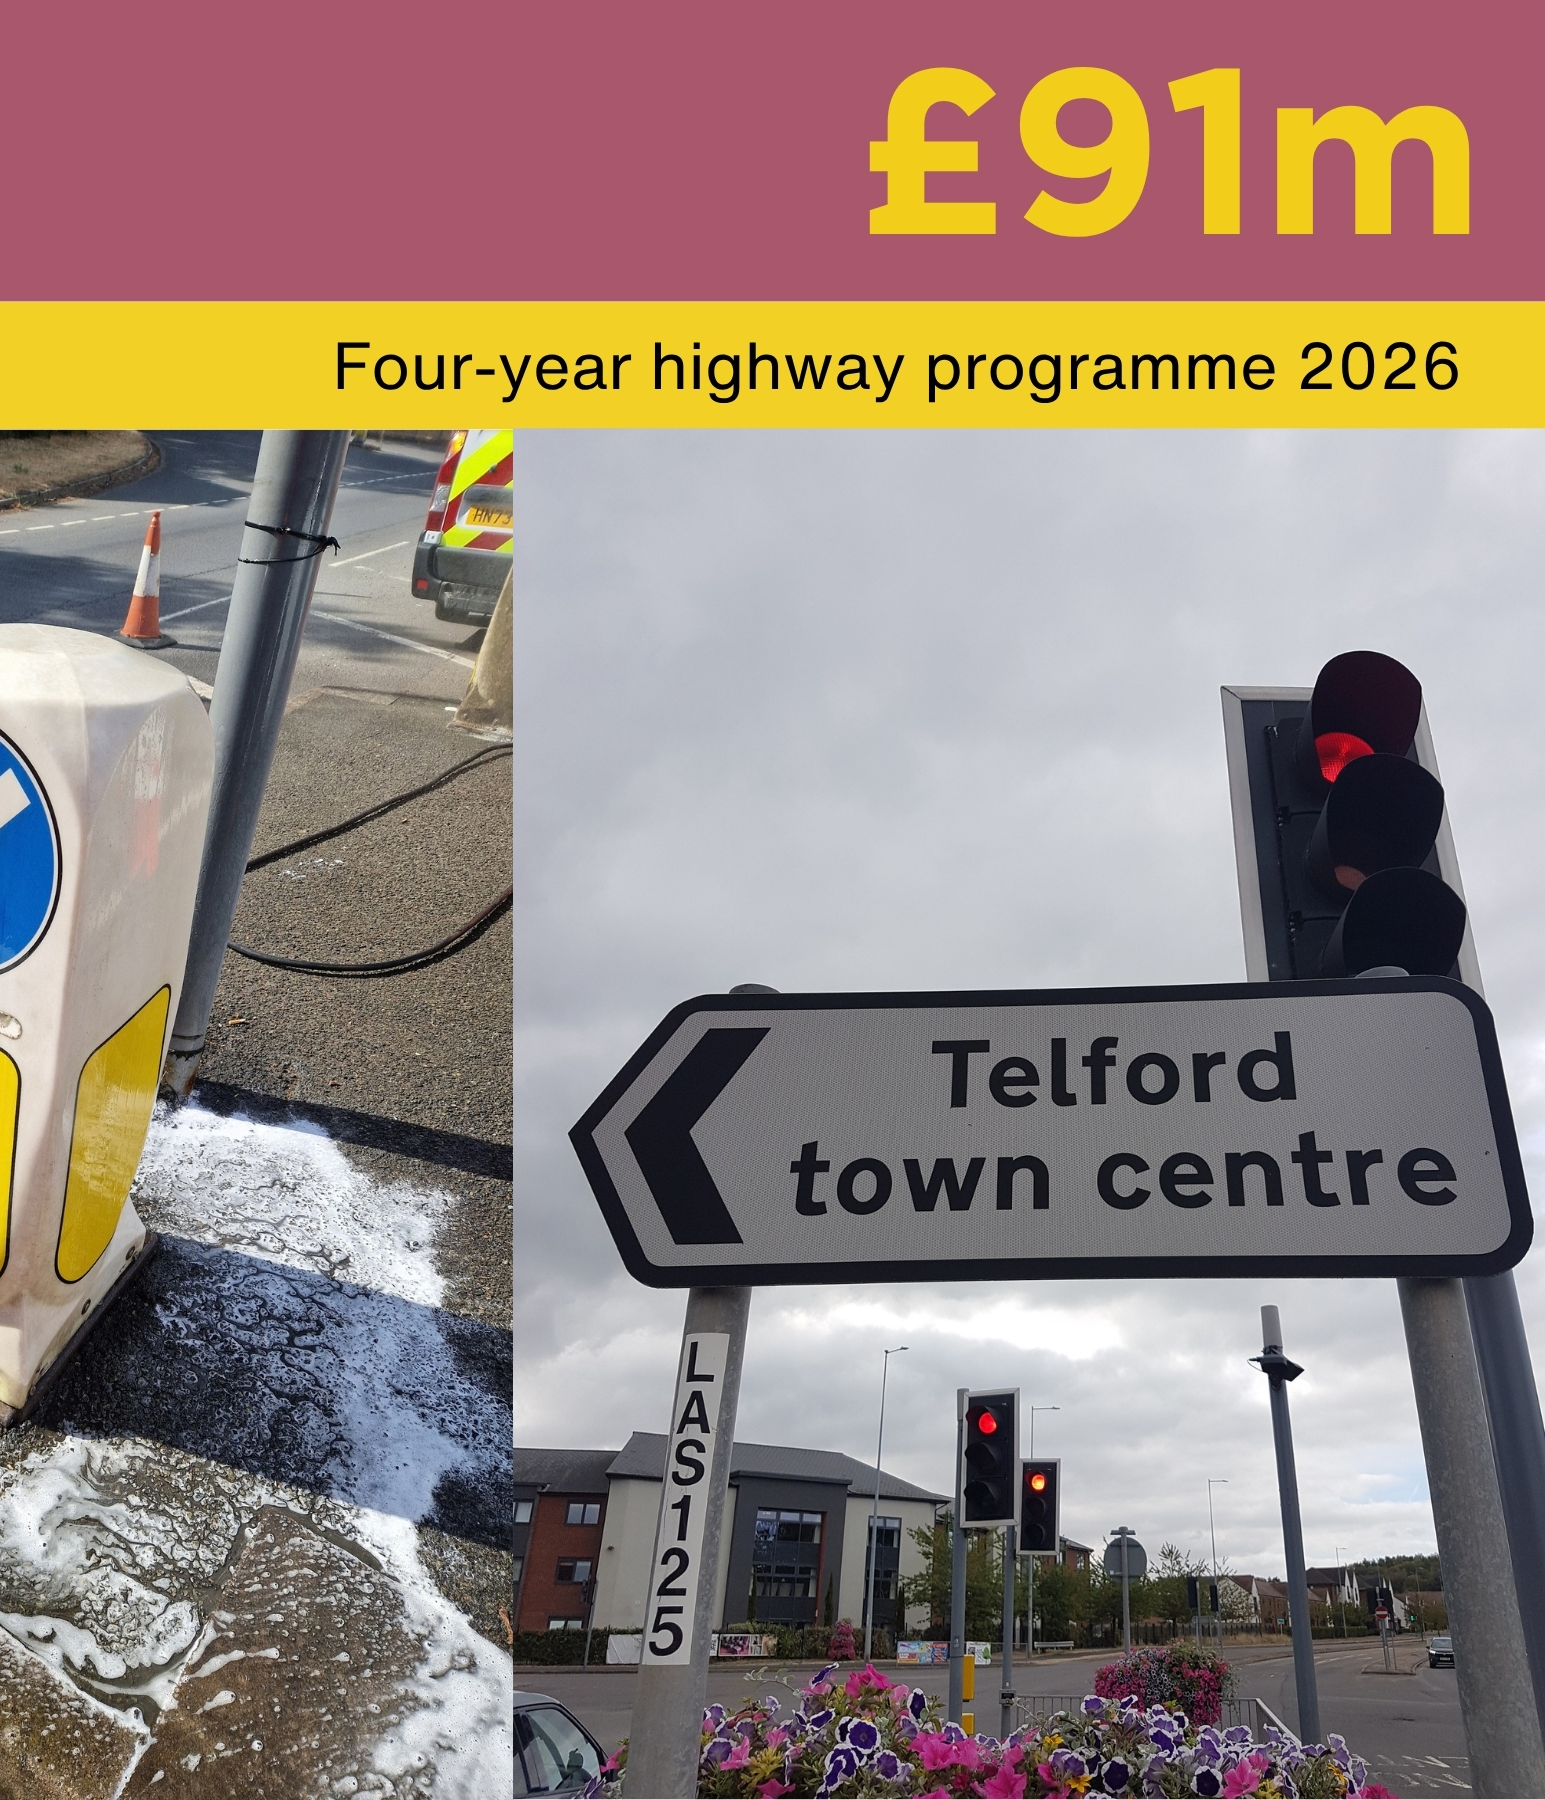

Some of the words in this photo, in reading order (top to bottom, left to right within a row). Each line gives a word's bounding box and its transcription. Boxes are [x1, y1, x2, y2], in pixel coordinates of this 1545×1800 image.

[932, 1031, 1296, 1109] Telford
[790, 1141, 1049, 1216] town
[1097, 1131, 1457, 1210] centre
